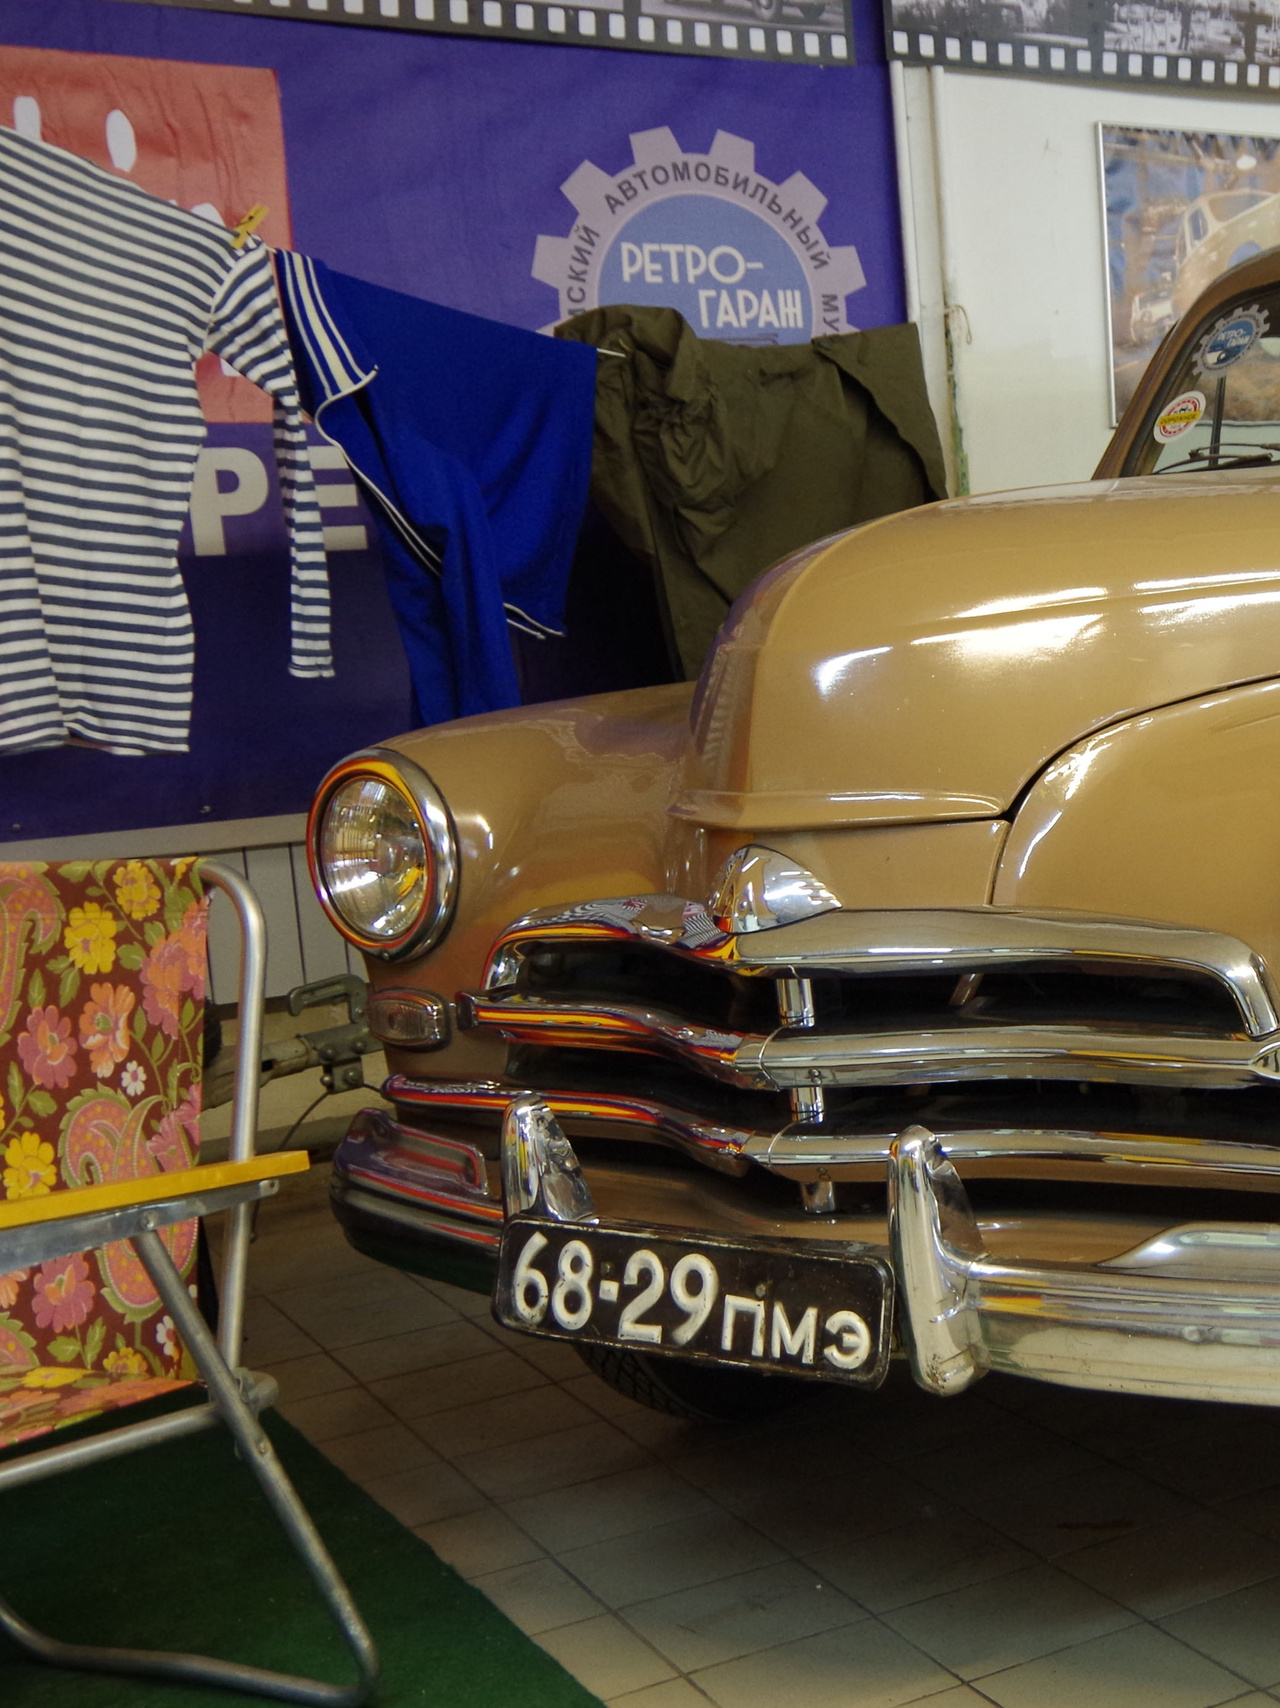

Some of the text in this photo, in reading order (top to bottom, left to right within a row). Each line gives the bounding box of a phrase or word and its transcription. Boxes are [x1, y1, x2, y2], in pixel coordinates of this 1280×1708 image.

[604, 161, 829, 270] АВТОМОБИЛЬНЫЙ
[821, 293, 840, 337] МУ
[620, 242, 764, 283] РЕТРО-
[698, 289, 804, 328] ГАРАЖ
